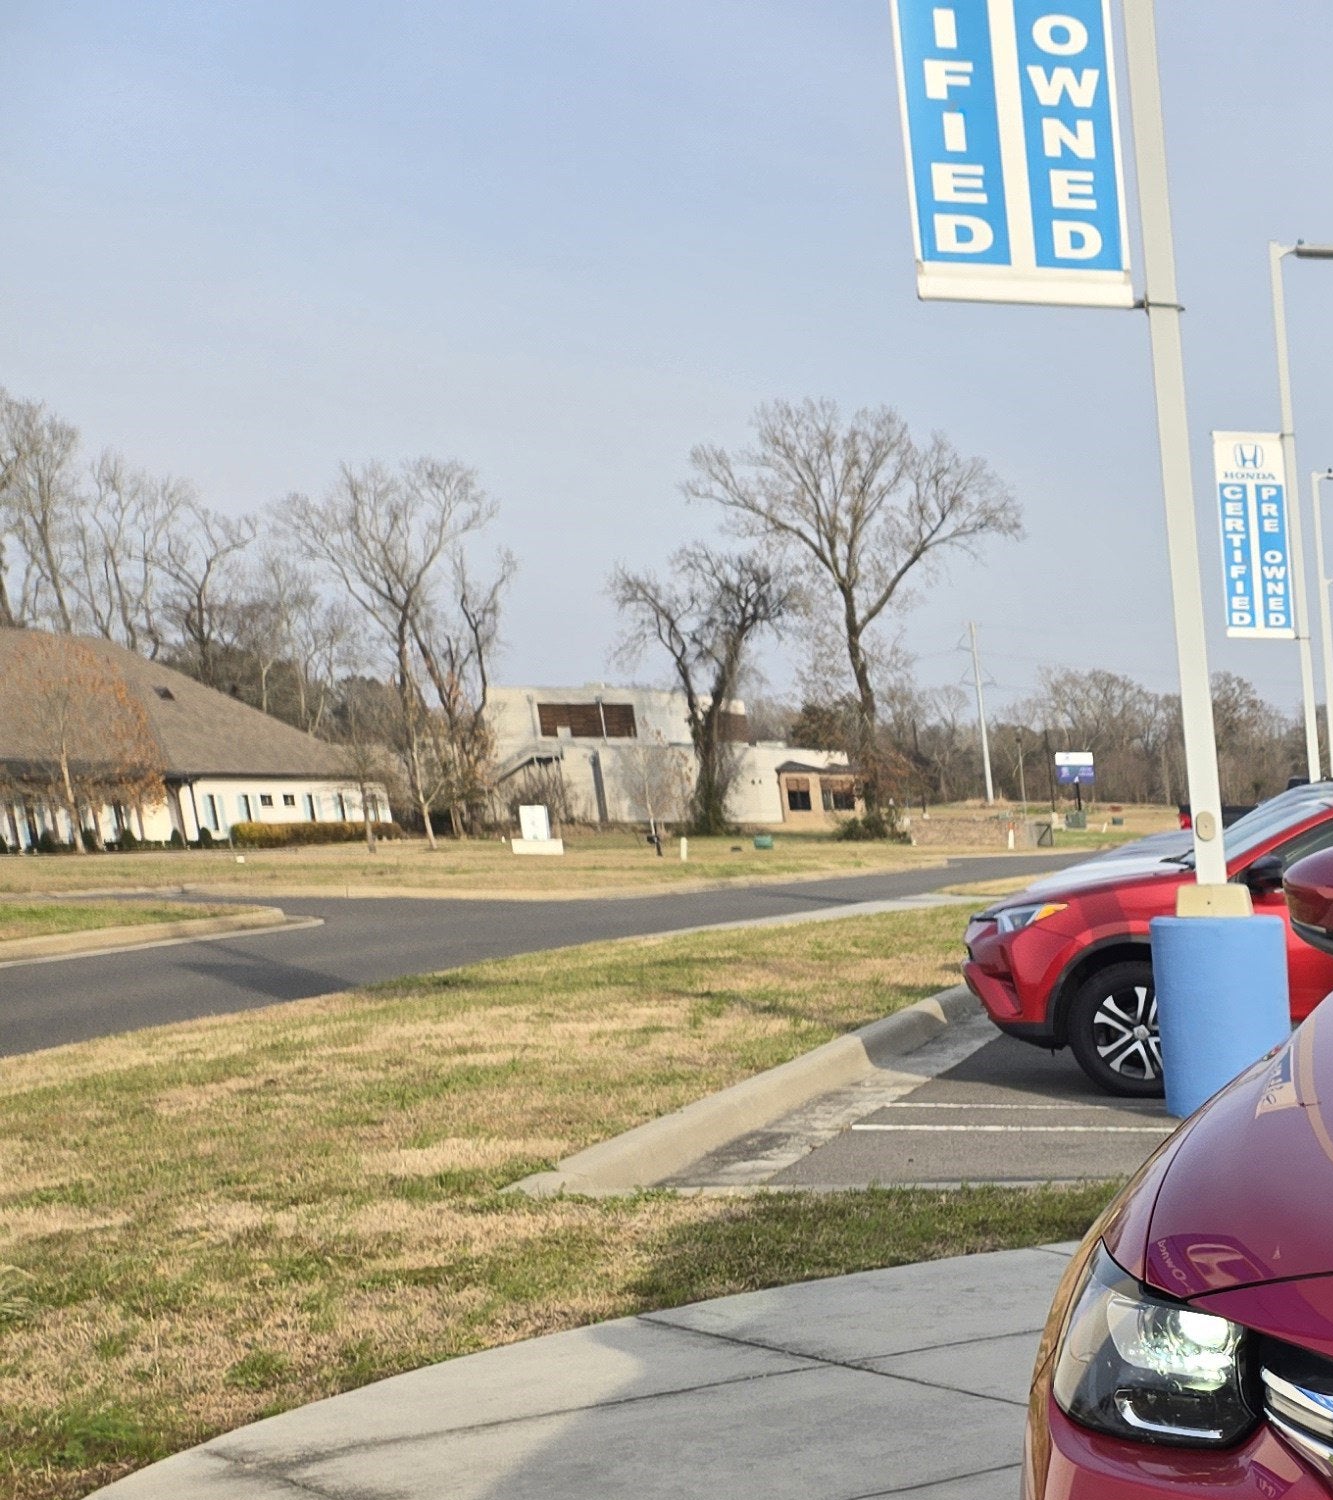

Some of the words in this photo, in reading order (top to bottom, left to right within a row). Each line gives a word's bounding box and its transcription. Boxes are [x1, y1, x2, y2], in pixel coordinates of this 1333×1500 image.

[1026, 13, 1103, 261] OWNED
[1223, 471, 1276, 480] HONDA
[1260, 486, 1280, 533] PRE
[1222, 485, 1252, 626] CERTIFIED
[1262, 549, 1287, 627] OWNED
